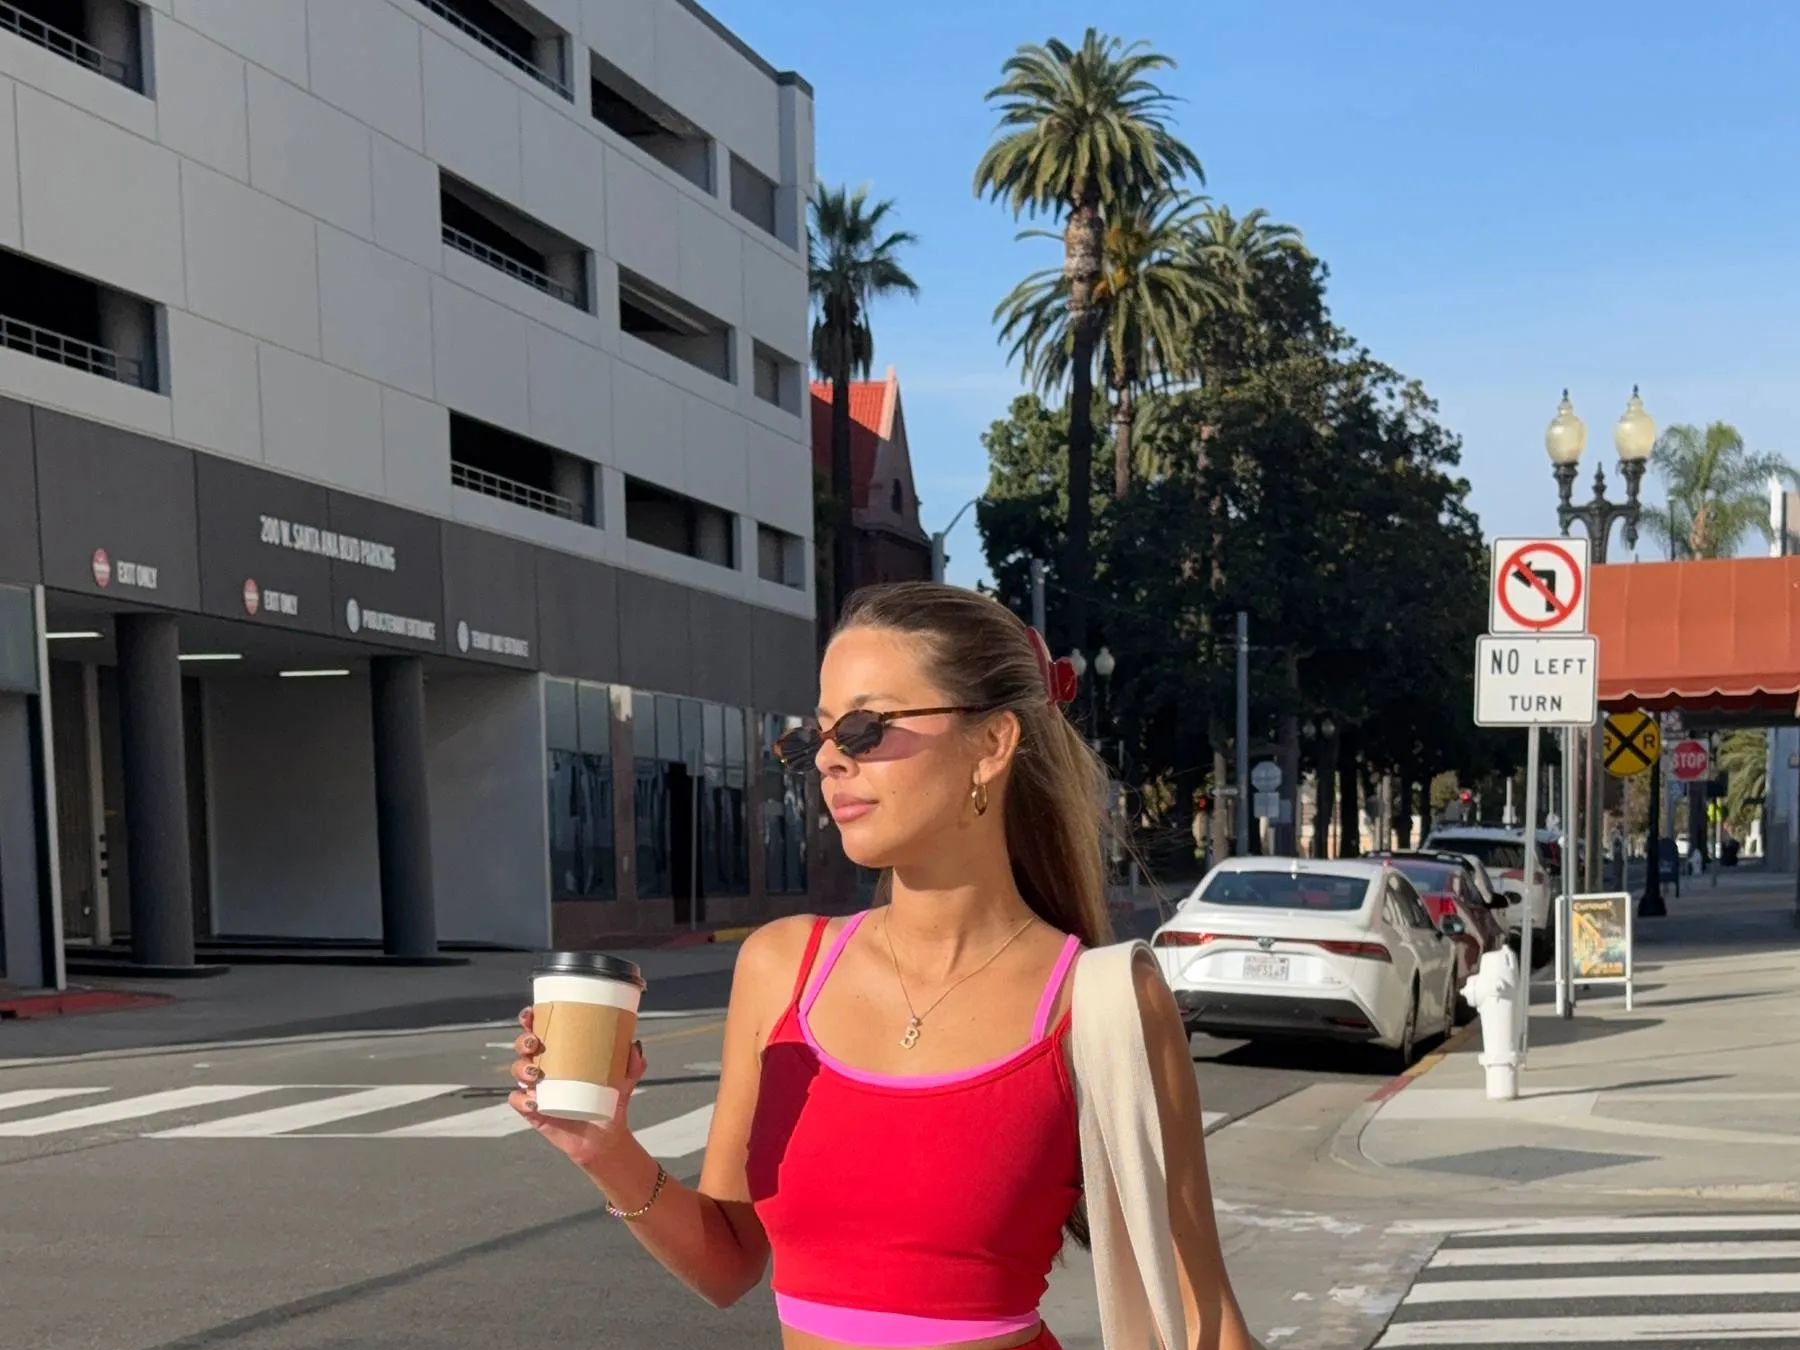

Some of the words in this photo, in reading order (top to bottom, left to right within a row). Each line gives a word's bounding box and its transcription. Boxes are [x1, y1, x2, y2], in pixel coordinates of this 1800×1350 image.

[260, 515, 280, 545] 200
[293, 523, 320, 555] SANTA
[360, 540, 396, 572] PARKING
[117, 560, 136, 585] EXIT
[137, 565, 158, 588] ONLY
[263, 590, 280, 611] EXIT
[280, 593, 298, 615] ONLY
[1491, 648, 1519, 675] NO
[1534, 658, 1587, 675] LEFT
[1508, 695, 1562, 712] TURN
[1643, 734, 1656, 750] R
[1673, 752, 1706, 769] STOP
